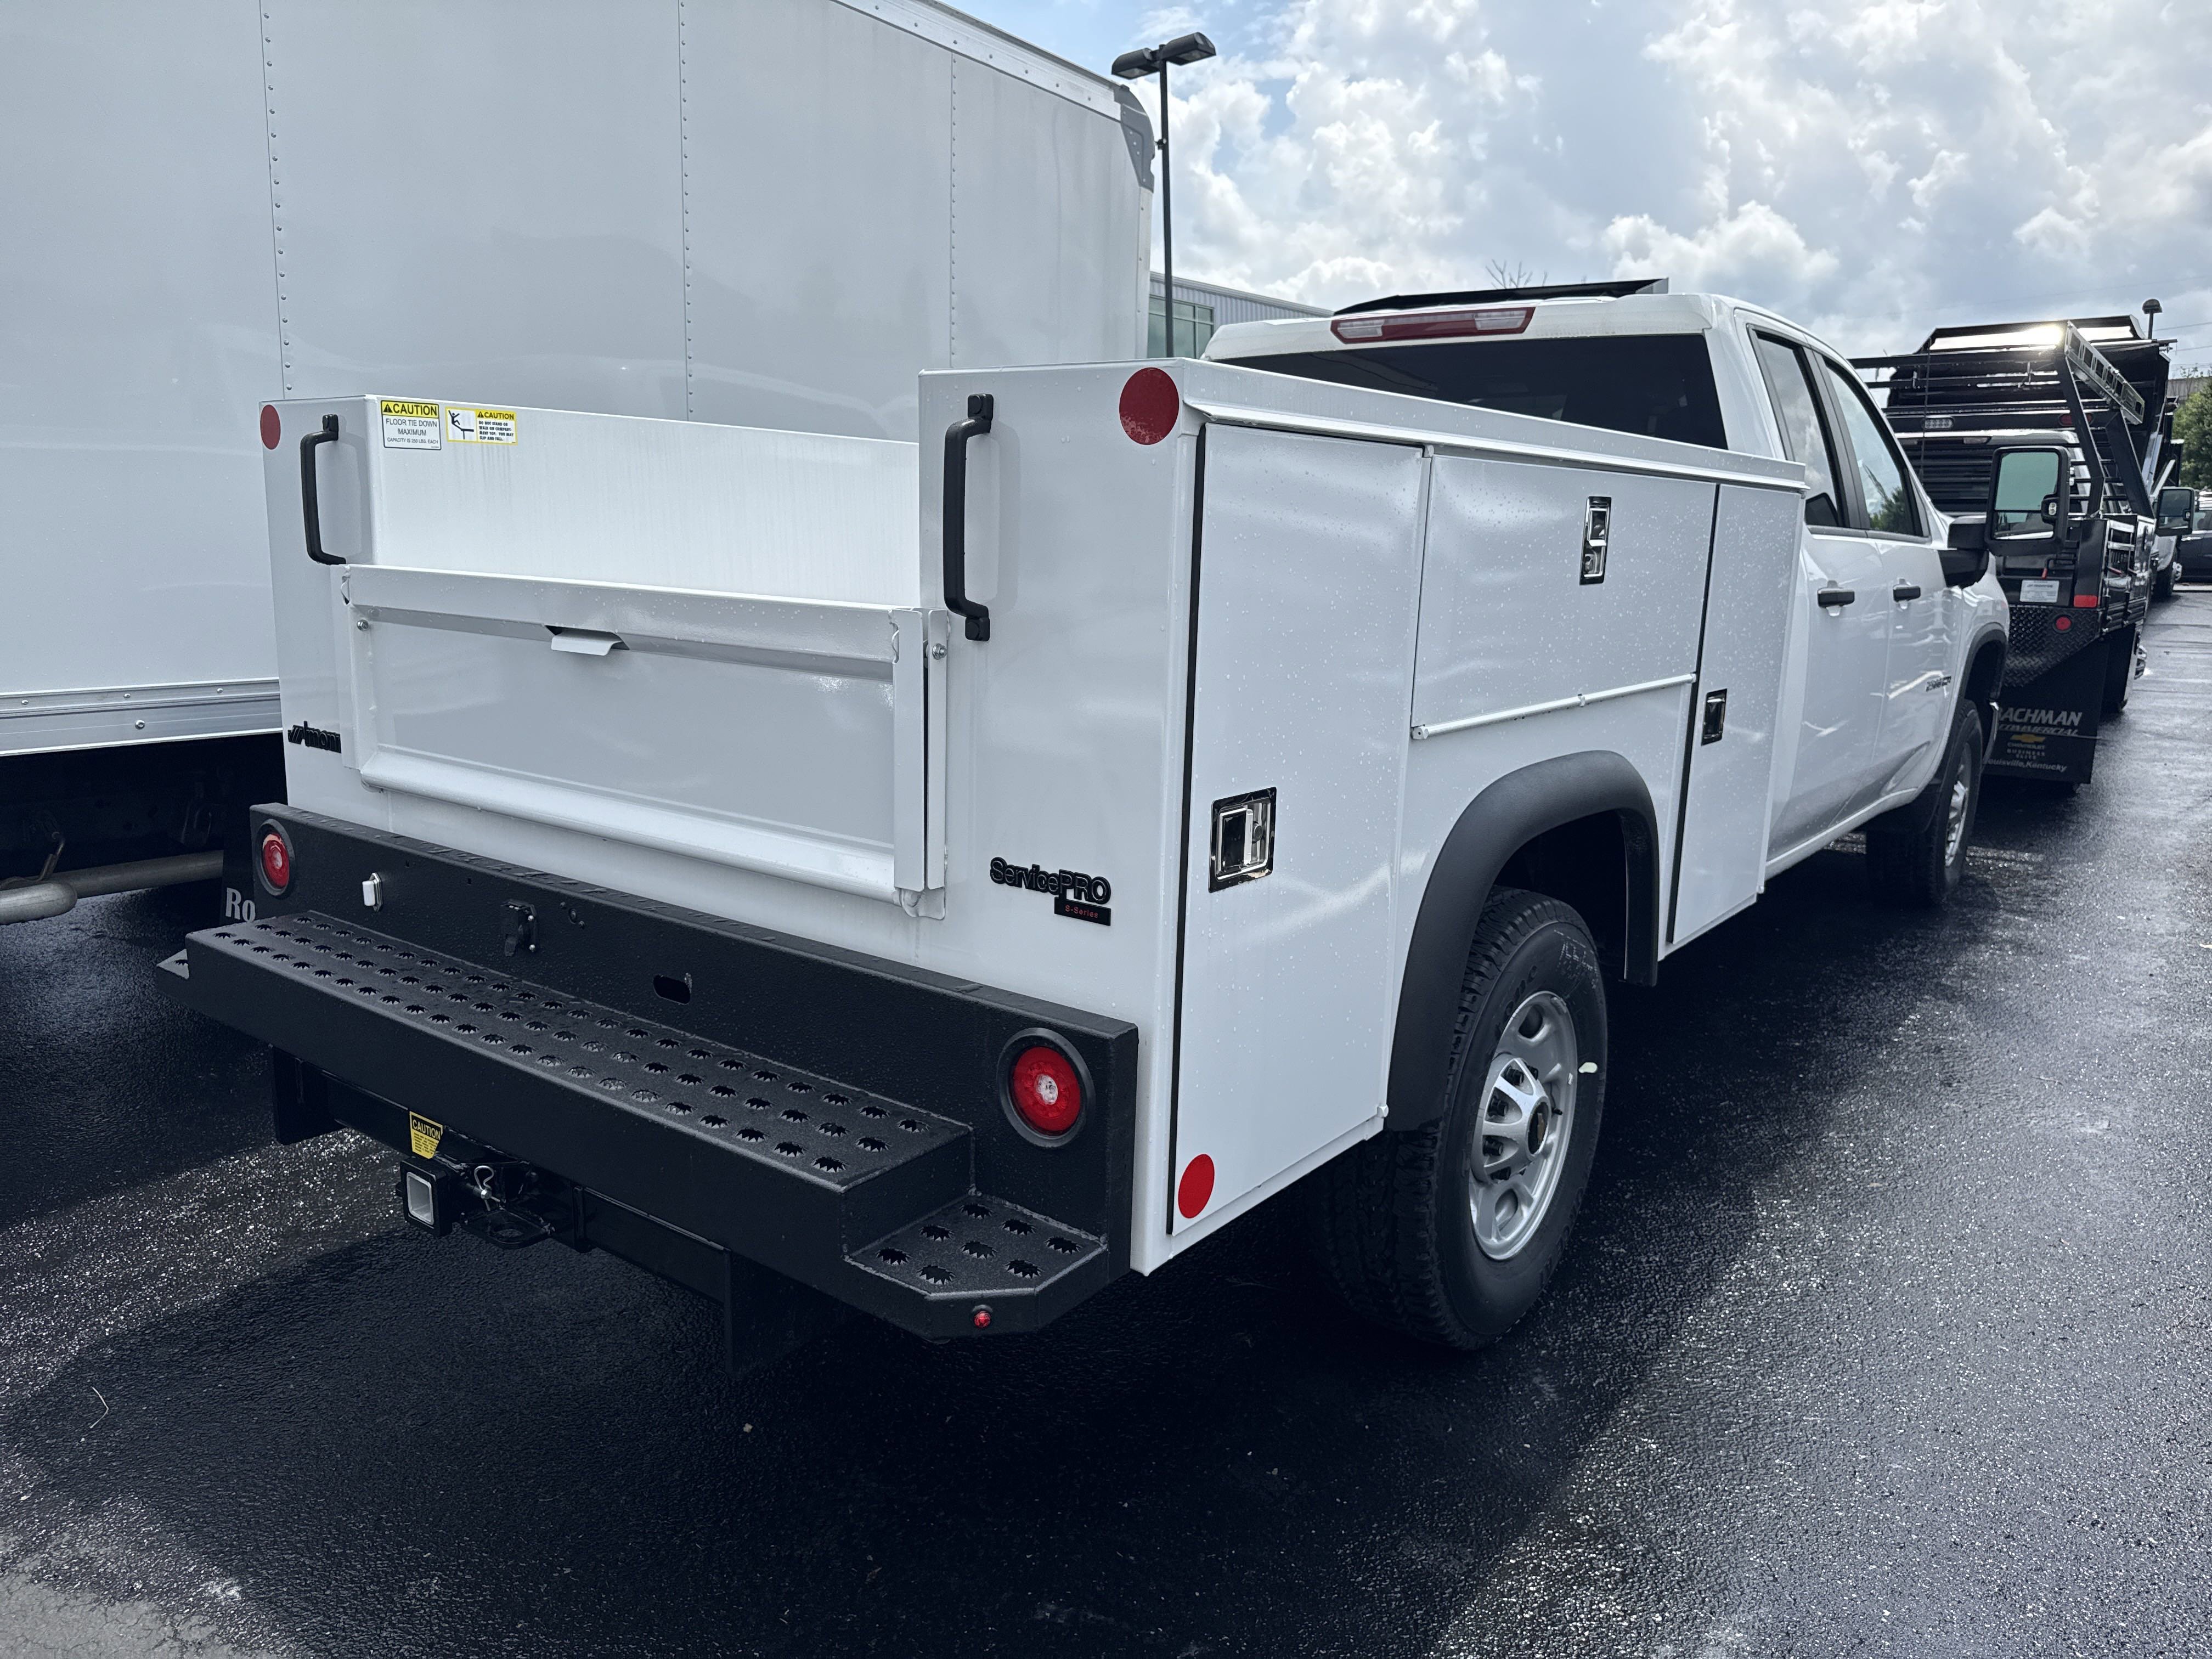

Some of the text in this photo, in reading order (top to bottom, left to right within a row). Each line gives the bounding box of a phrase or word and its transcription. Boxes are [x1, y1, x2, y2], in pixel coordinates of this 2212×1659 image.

[393, 404, 437, 416] CAUTION
[990, 857, 1111, 904] ServicePRO
[1065, 905, 1098, 918] S-Series
[413, 1119, 441, 1141] CAUTION
